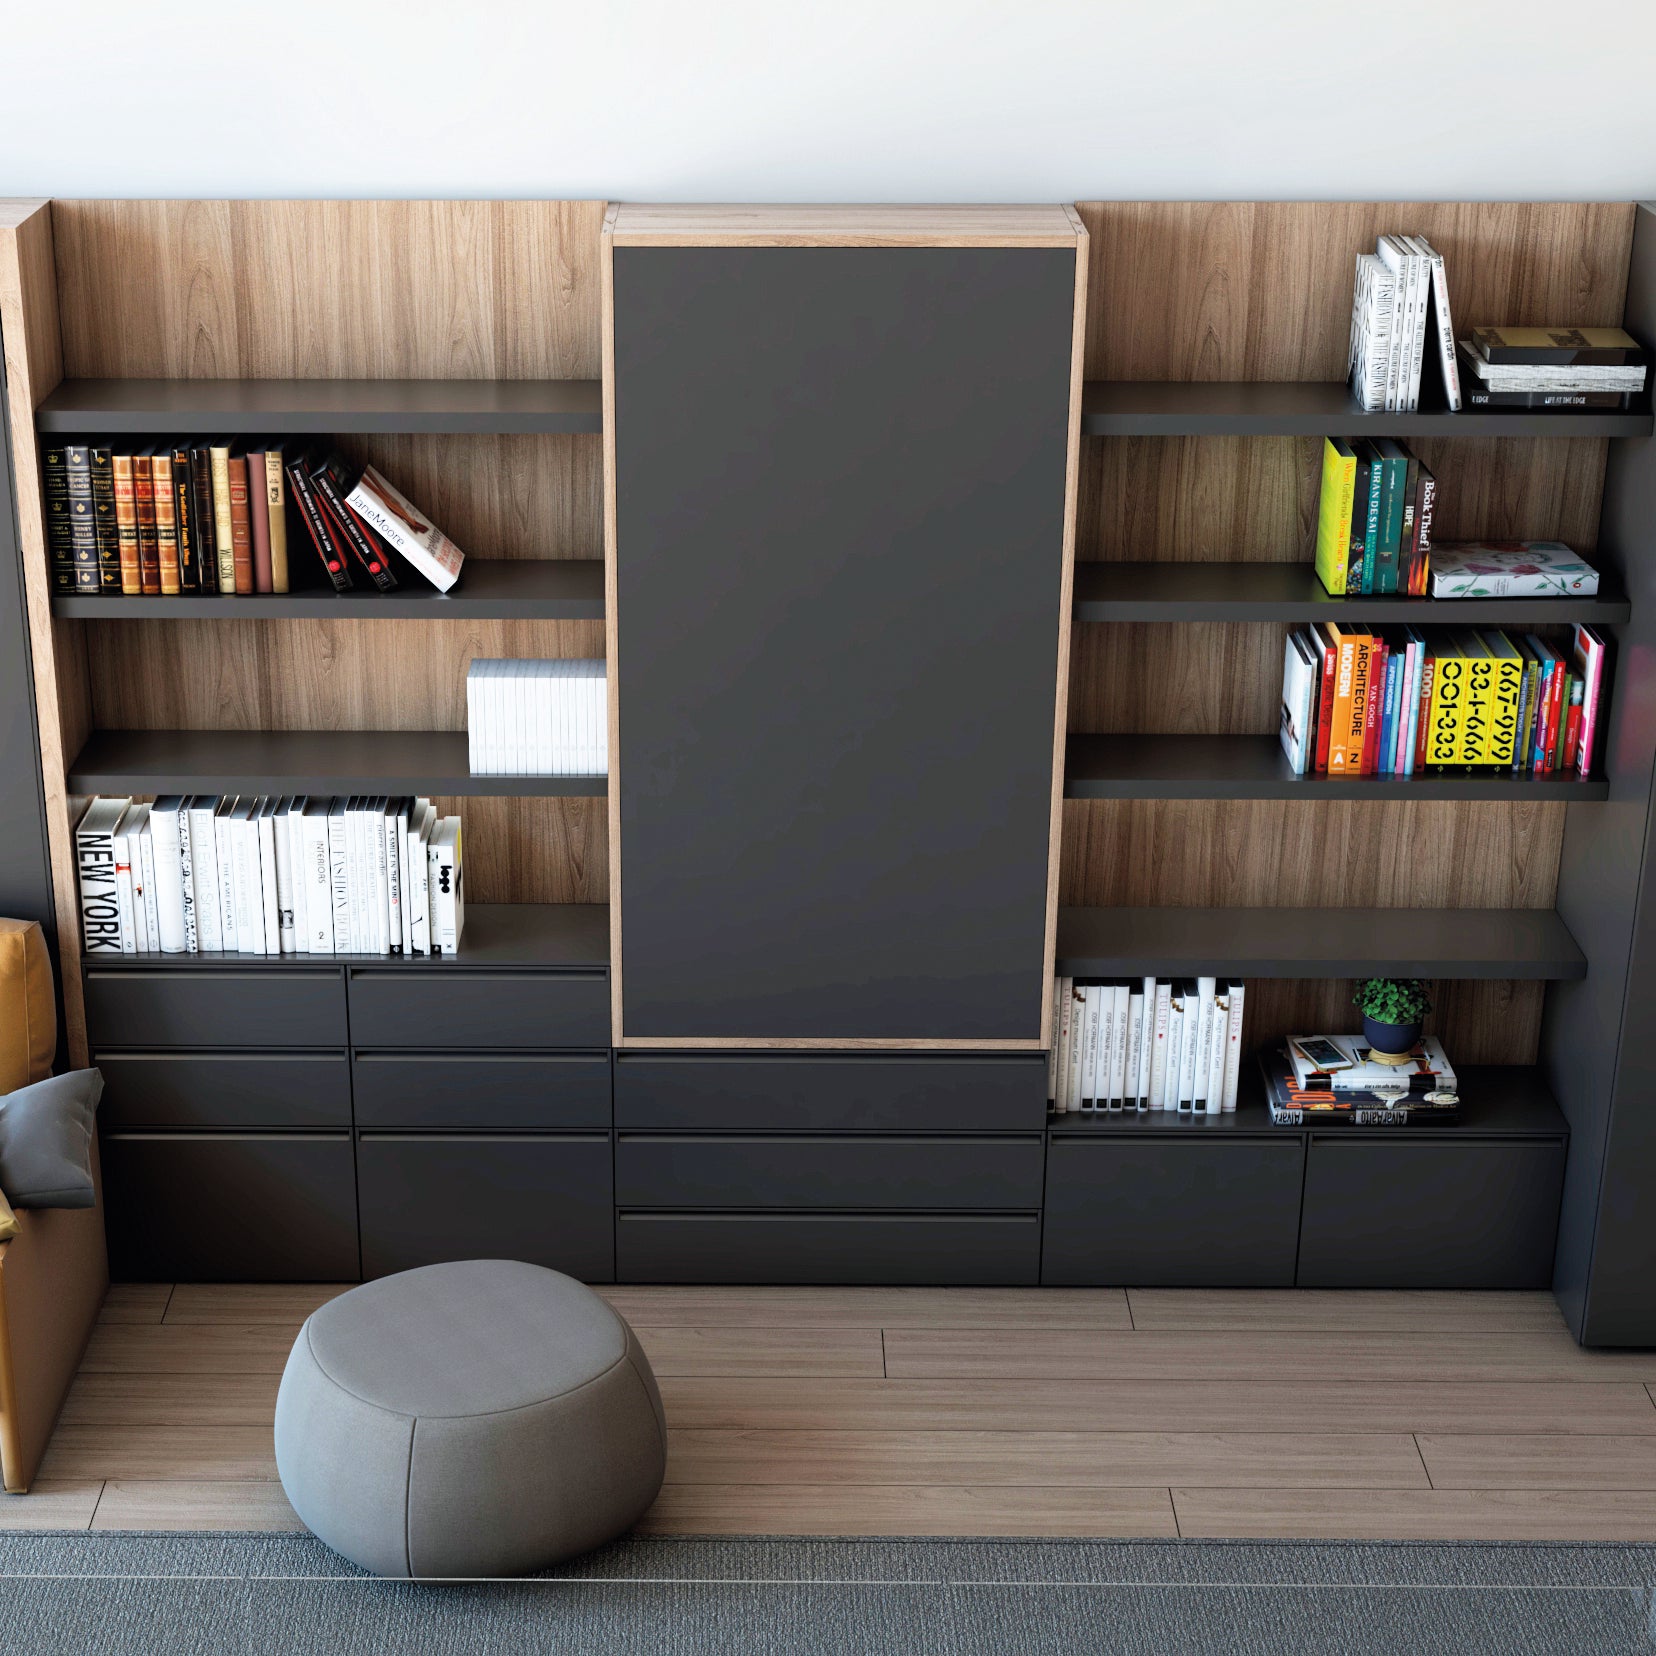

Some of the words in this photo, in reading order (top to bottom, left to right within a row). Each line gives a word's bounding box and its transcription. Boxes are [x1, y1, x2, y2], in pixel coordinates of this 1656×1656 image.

[1443, 327, 1453, 343] pierre
[1446, 344, 1455, 360] cardin
[1371, 357, 1387, 388] FASHION
[1413, 356, 1421, 375] BEAUTY
[1343, 462, 1353, 482] When
[1372, 464, 1383, 499] KIRAN
[1339, 483, 1352, 519] Girlfriends
[1422, 481, 1435, 513] Book
[351, 494, 405, 546] JaneMoore
[1338, 520, 1348, 539] Break
[1404, 505, 1414, 527] HOPE
[1419, 512, 1433, 546] Thief
[219, 549, 233, 579] WILLSON
[360, 542, 370, 554] JAPAN
[1336, 540, 1347, 562] Hearts
[1326, 654, 1336, 675] Swiss
[1338, 643, 1355, 698] MODERN
[1421, 663, 1434, 698] 1000
[1351, 644, 1370, 737] ARCHITECTURE
[1385, 685, 1394, 714] MODERN
[1526, 663, 1536, 706] PATTERNS
[1367, 704, 1376, 728] GOGH
[1434, 661, 1462, 760] 001-333
[1463, 662, 1491, 761] 334-666
[1491, 662, 1521, 760] 667-999
[1516, 714, 1524, 733] TODAY
[1334, 752, 1344, 764] A
[1350, 753, 1359, 763] Z
[331, 821, 343, 847] THE
[78, 834, 115, 883] NEW
[316, 841, 325, 884] INTERIORS
[332, 851, 348, 908] FASHION
[83, 891, 120, 950] YORK
[224, 882, 233, 931] AMERICANS
[319, 932, 324, 940] 2
[337, 913, 350, 950] BOOK
[1063, 987, 1071, 1026] TULIPS
[1158, 994, 1168, 1030] TULIPS
[1231, 996, 1241, 1033] TULIPS
